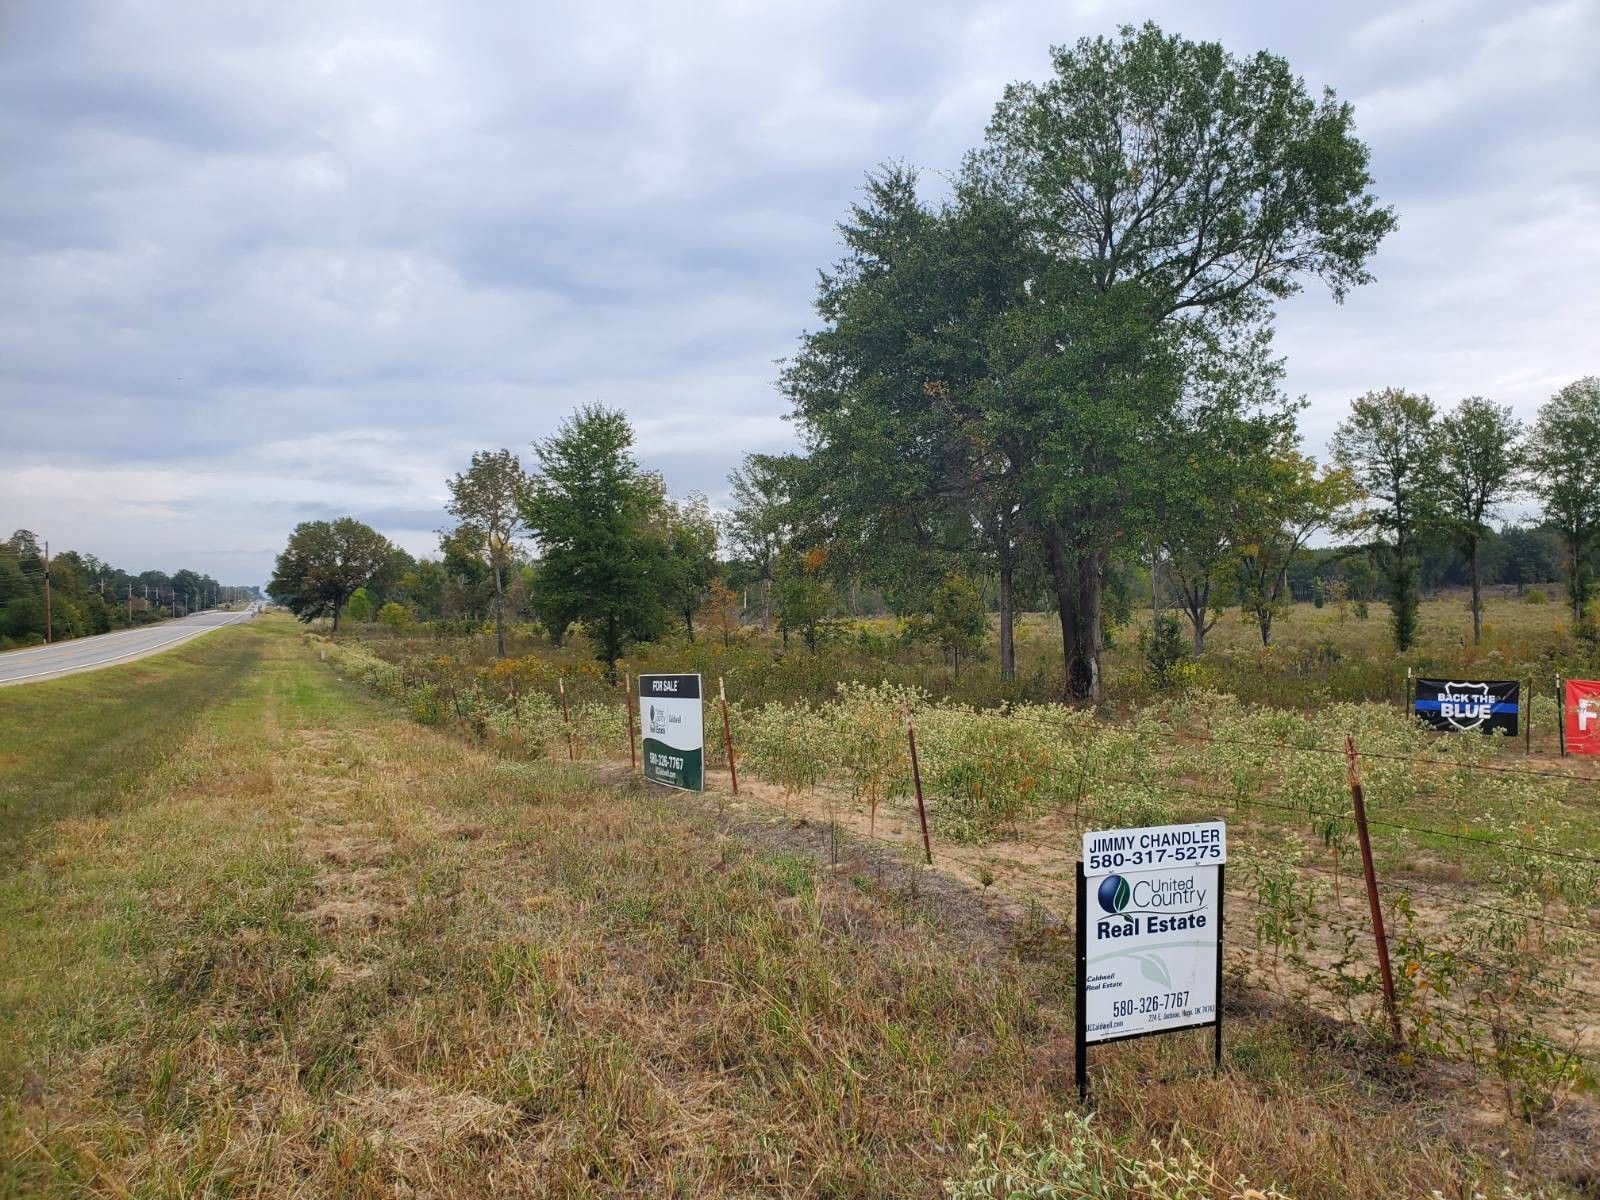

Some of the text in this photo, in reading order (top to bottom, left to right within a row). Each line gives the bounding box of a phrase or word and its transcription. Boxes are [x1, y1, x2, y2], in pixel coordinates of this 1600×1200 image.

[653, 680, 678, 691] FOR SALE
[1437, 693, 1496, 704] BACK THE
[1440, 703, 1492, 719] BLUE
[649, 752, 684, 770] 580-326-7767
[1089, 829, 1220, 854] JIMMY CHANDLER
[1090, 845, 1221, 869] 580-317-5275
[1151, 876, 1194, 893] United
[1132, 880, 1207, 908] Country
[1097, 913, 1206, 940] Real Estate
[1086, 972, 1115, 982] Caldwell
[1086, 981, 1123, 992] Real Estate
[1113, 990, 1190, 1018] 580-326-7767
[1194, 1006, 1201, 1016] OK
